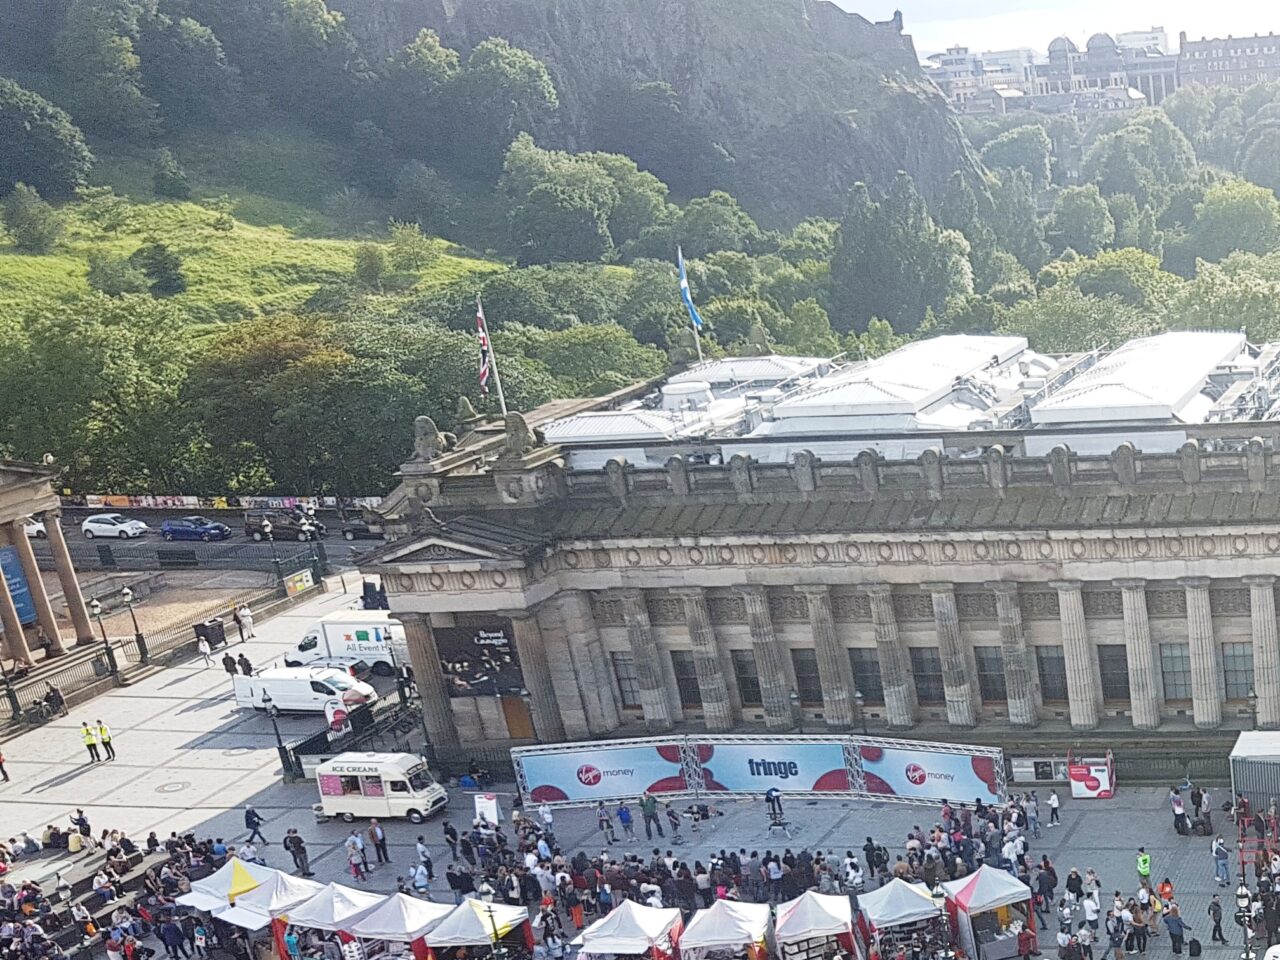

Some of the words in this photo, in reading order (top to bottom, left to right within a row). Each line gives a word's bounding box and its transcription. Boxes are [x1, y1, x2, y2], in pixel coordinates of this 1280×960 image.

[479, 629, 504, 639] Beyond
[346, 643, 357, 652] All
[360, 644, 380, 652] Event
[578, 765, 600, 784] Virgin
[602, 768, 635, 777] money
[747, 758, 799, 779] fringe
[907, 764, 925, 784] Virgin
[927, 772, 956, 783] money
